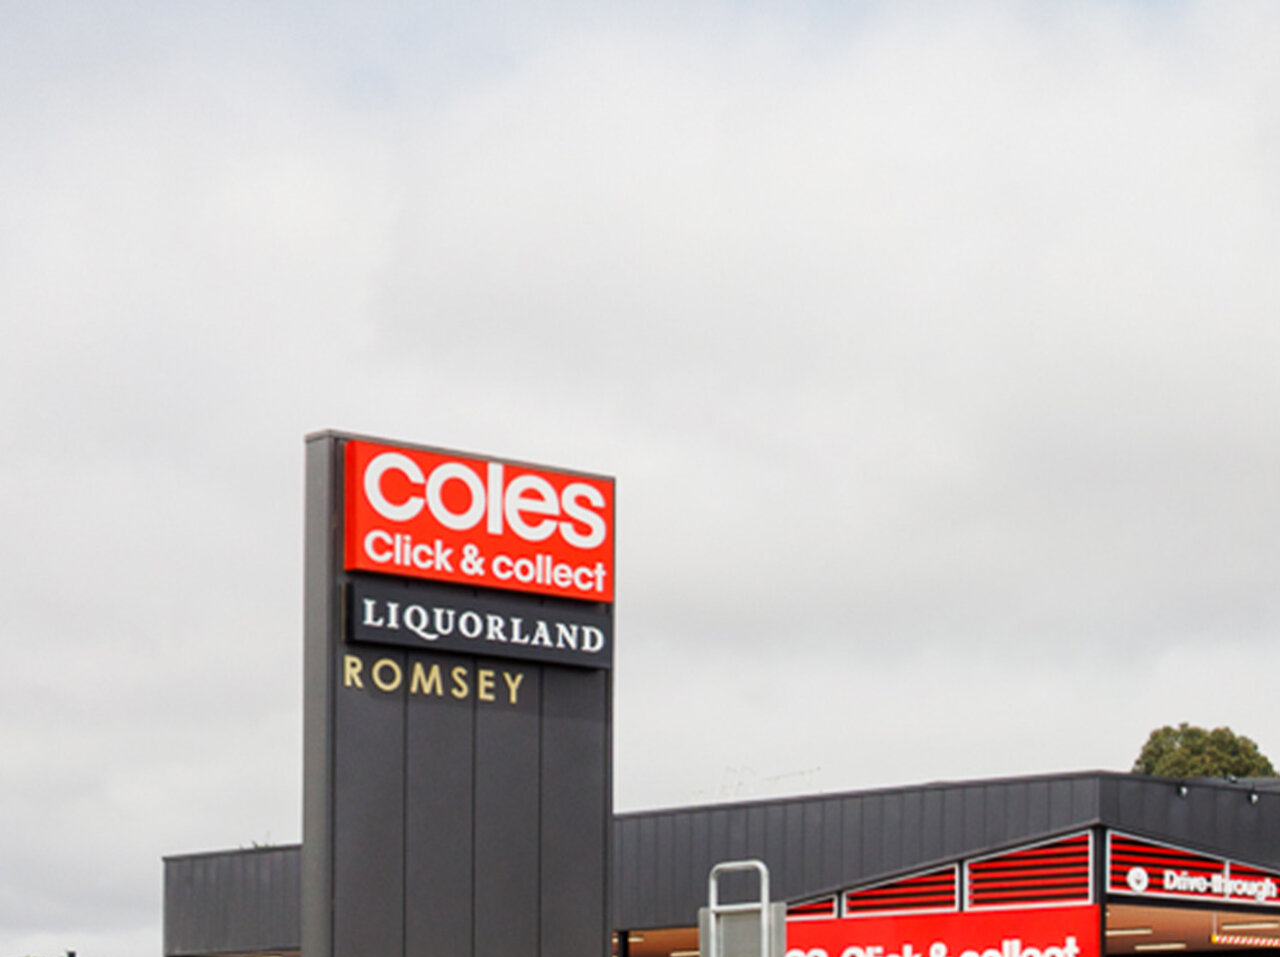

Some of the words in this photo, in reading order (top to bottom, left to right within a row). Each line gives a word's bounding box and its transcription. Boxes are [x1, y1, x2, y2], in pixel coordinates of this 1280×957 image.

[364, 452, 606, 549] coles
[364, 530, 453, 573] Click
[460, 543, 485, 576] &
[492, 554, 606, 592] collect
[363, 599, 604, 652] LIQUORLAND
[344, 655, 523, 704] ROMSEY
[1163, 869, 1277, 901] Drive-through
